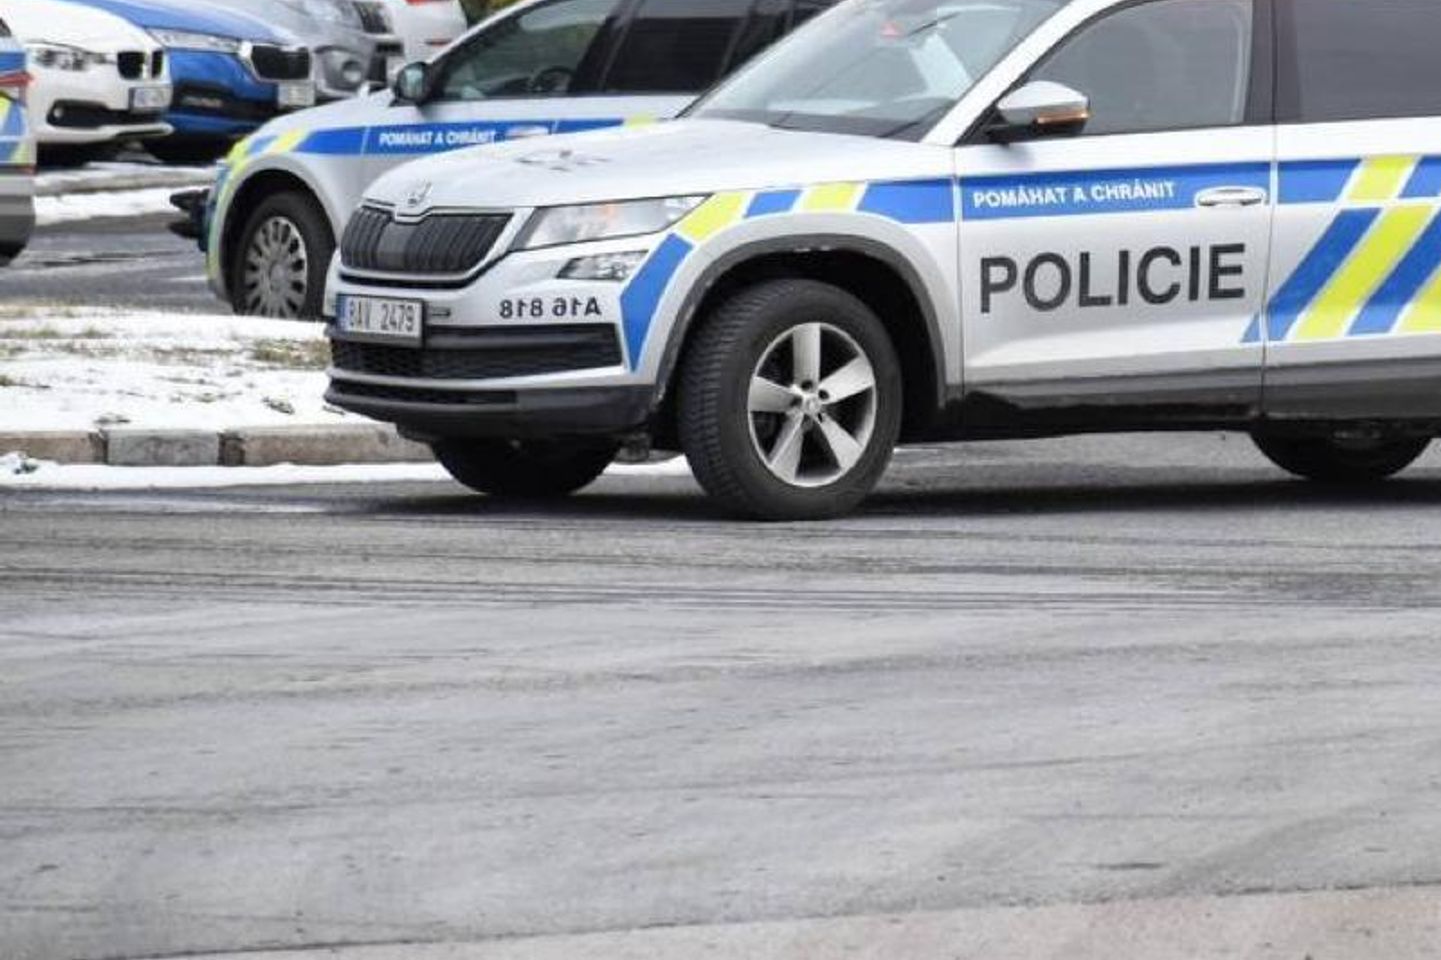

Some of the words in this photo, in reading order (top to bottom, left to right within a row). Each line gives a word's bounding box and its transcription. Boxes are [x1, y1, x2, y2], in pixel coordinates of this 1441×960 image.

[434, 132, 443, 145] A
[973, 186, 1068, 208] POMÁHAT
[1073, 188, 1085, 203] A
[1091, 179, 1175, 202] CHRÁNIT
[980, 243, 1245, 313] POLICIE
[380, 302, 415, 333] 2479
